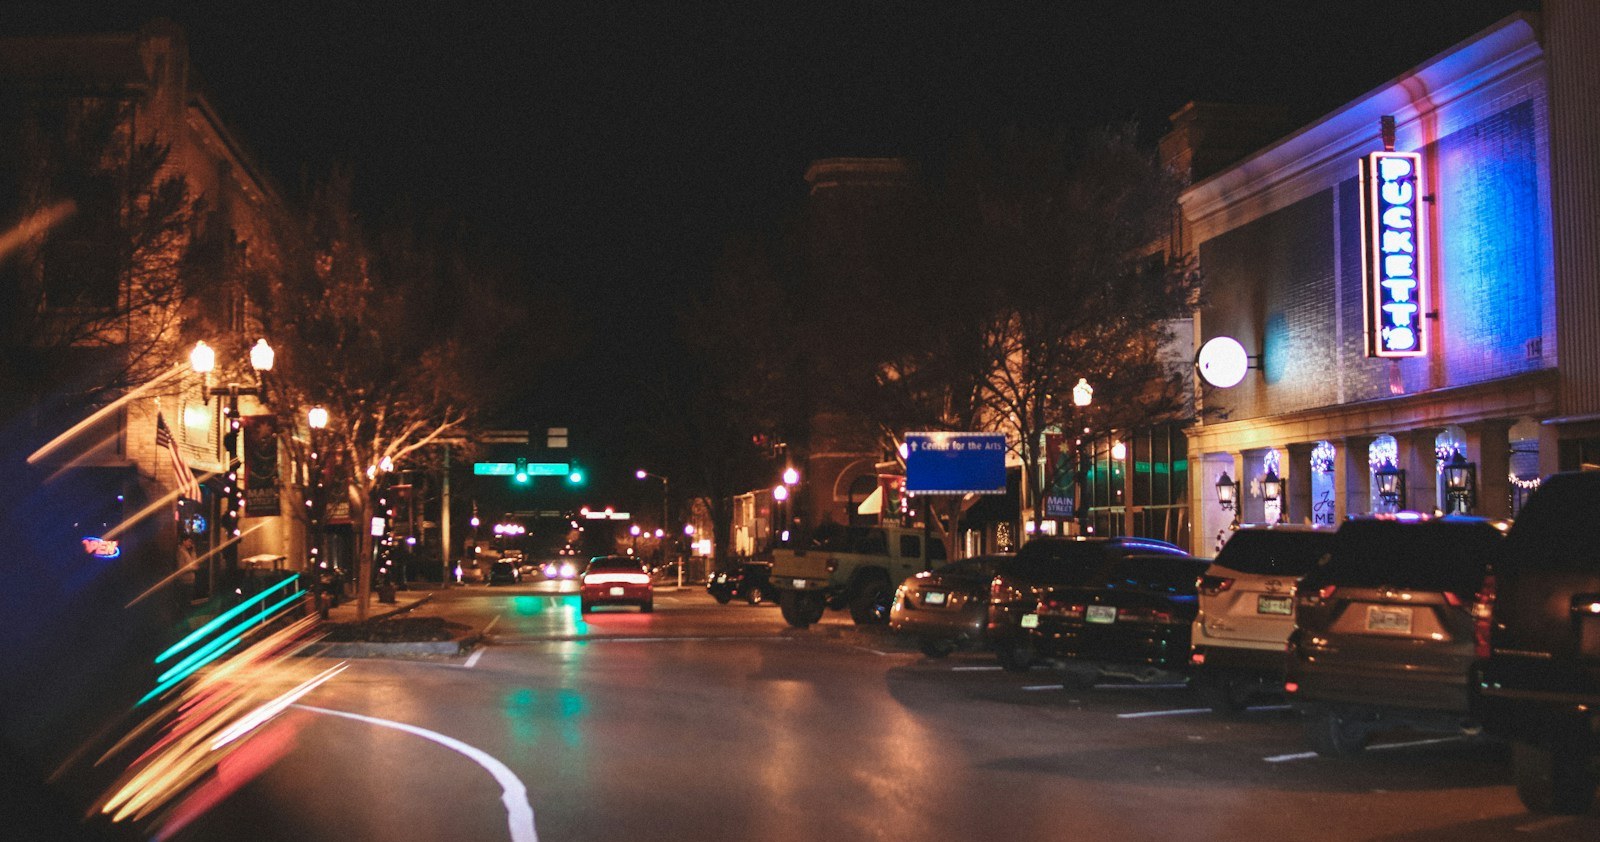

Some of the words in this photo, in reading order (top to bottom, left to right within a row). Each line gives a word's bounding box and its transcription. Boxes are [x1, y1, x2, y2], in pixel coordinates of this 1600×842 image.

[1380, 156, 1418, 351] PUCKETT'S
[921, 441, 950, 451] Center
[952, 440, 965, 451] for
[967, 441, 982, 450] the
[984, 441, 1001, 450] Arts
[1047, 495, 1073, 506] MAIN
[1047, 504, 1073, 513] STREET
